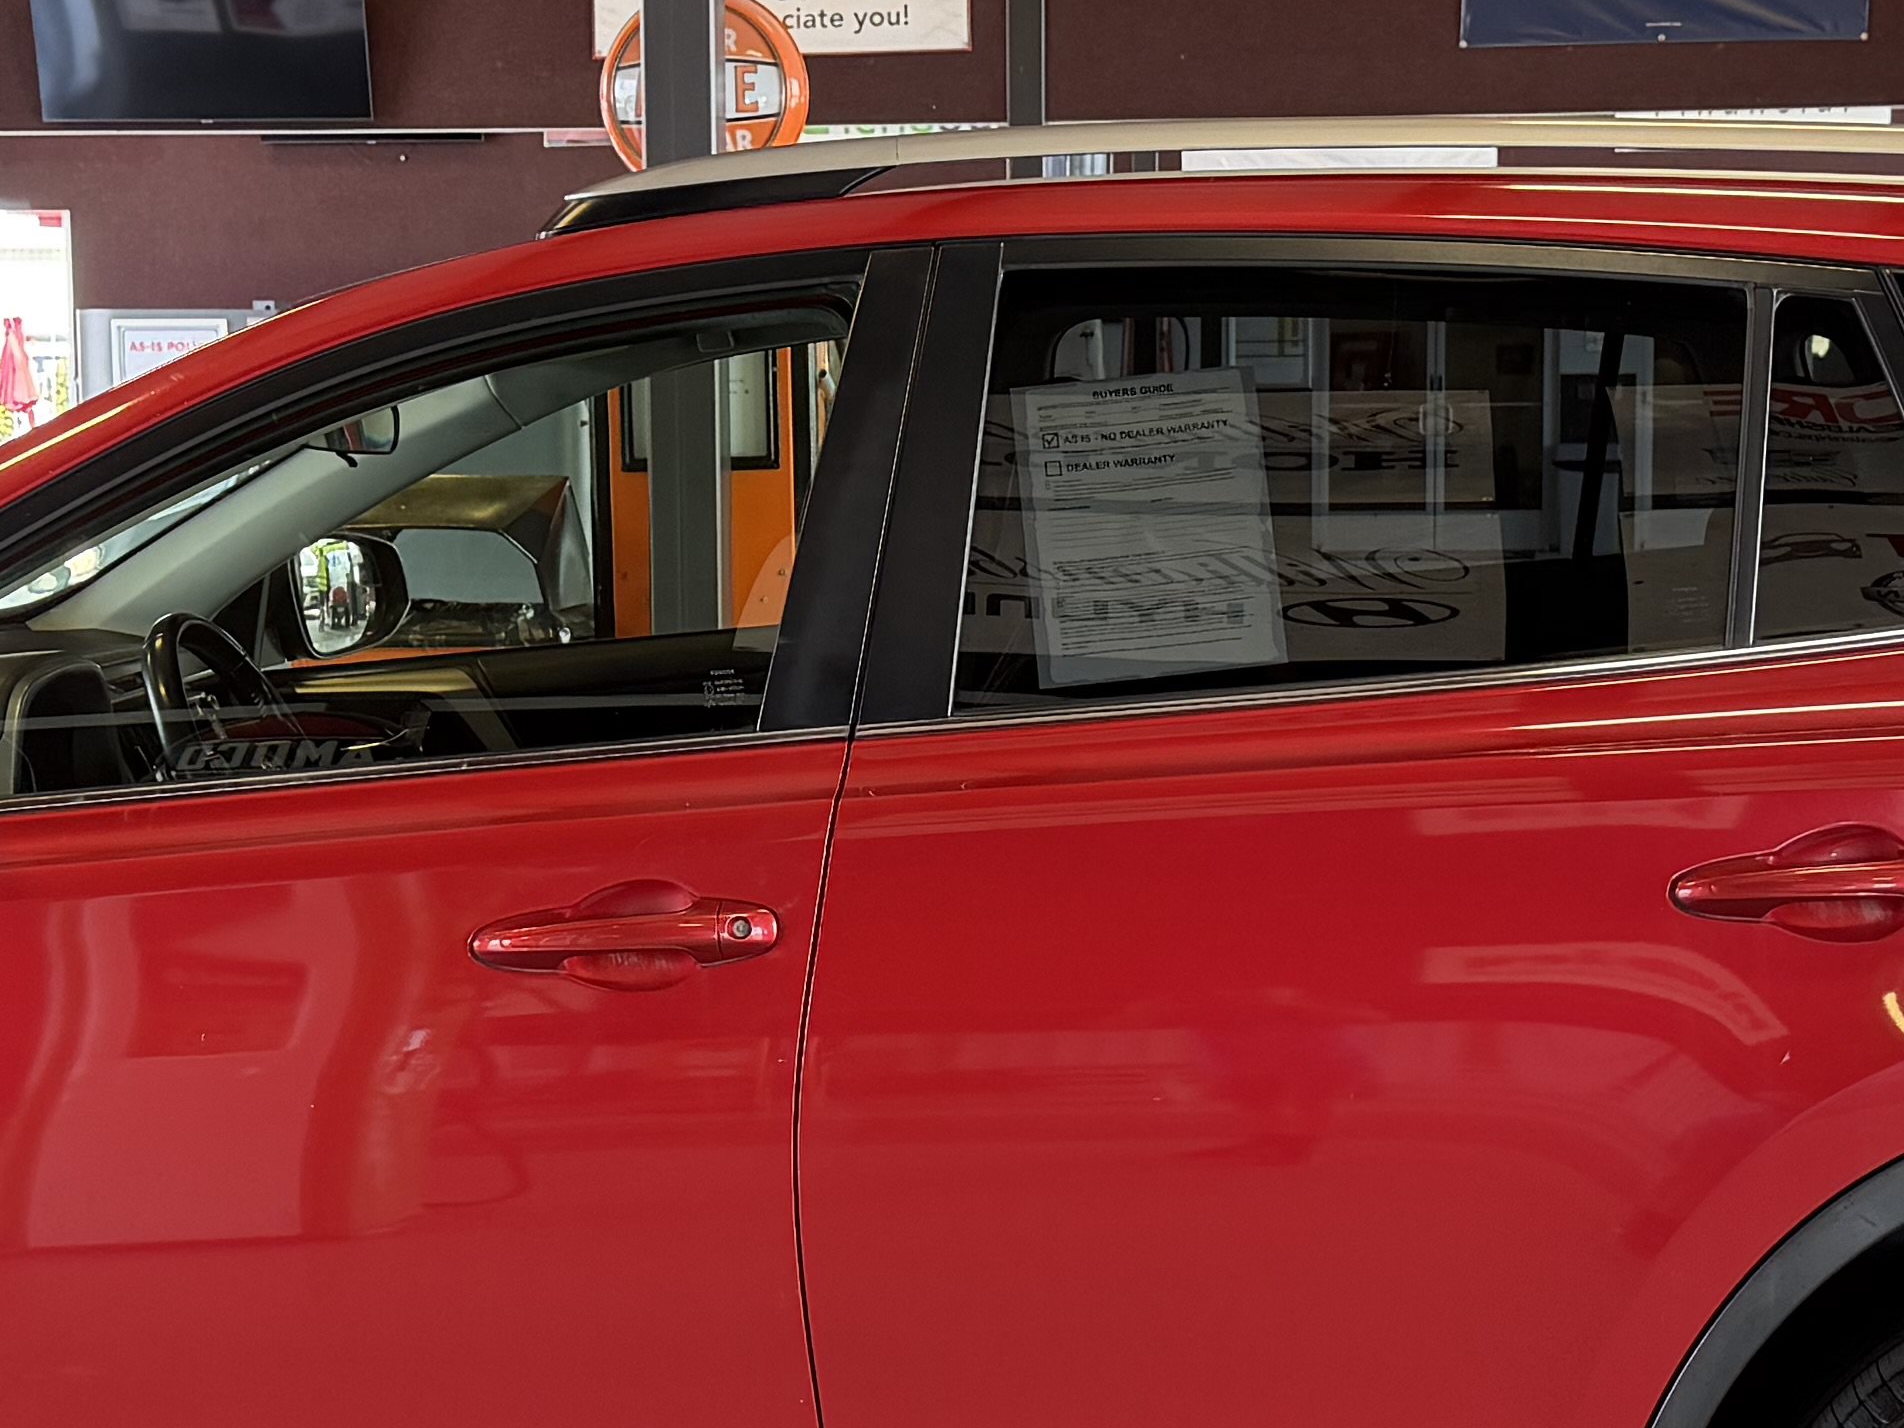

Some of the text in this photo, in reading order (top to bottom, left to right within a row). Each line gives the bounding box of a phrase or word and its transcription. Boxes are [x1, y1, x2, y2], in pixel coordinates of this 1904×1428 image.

[852, 3, 911, 35] you!
[1119, 426, 1165, 441] DEALER
[1167, 417, 1229, 436] WARRANTY
[1066, 460, 1111, 474] DEALER
[1113, 453, 1177, 470] WARRANTY
